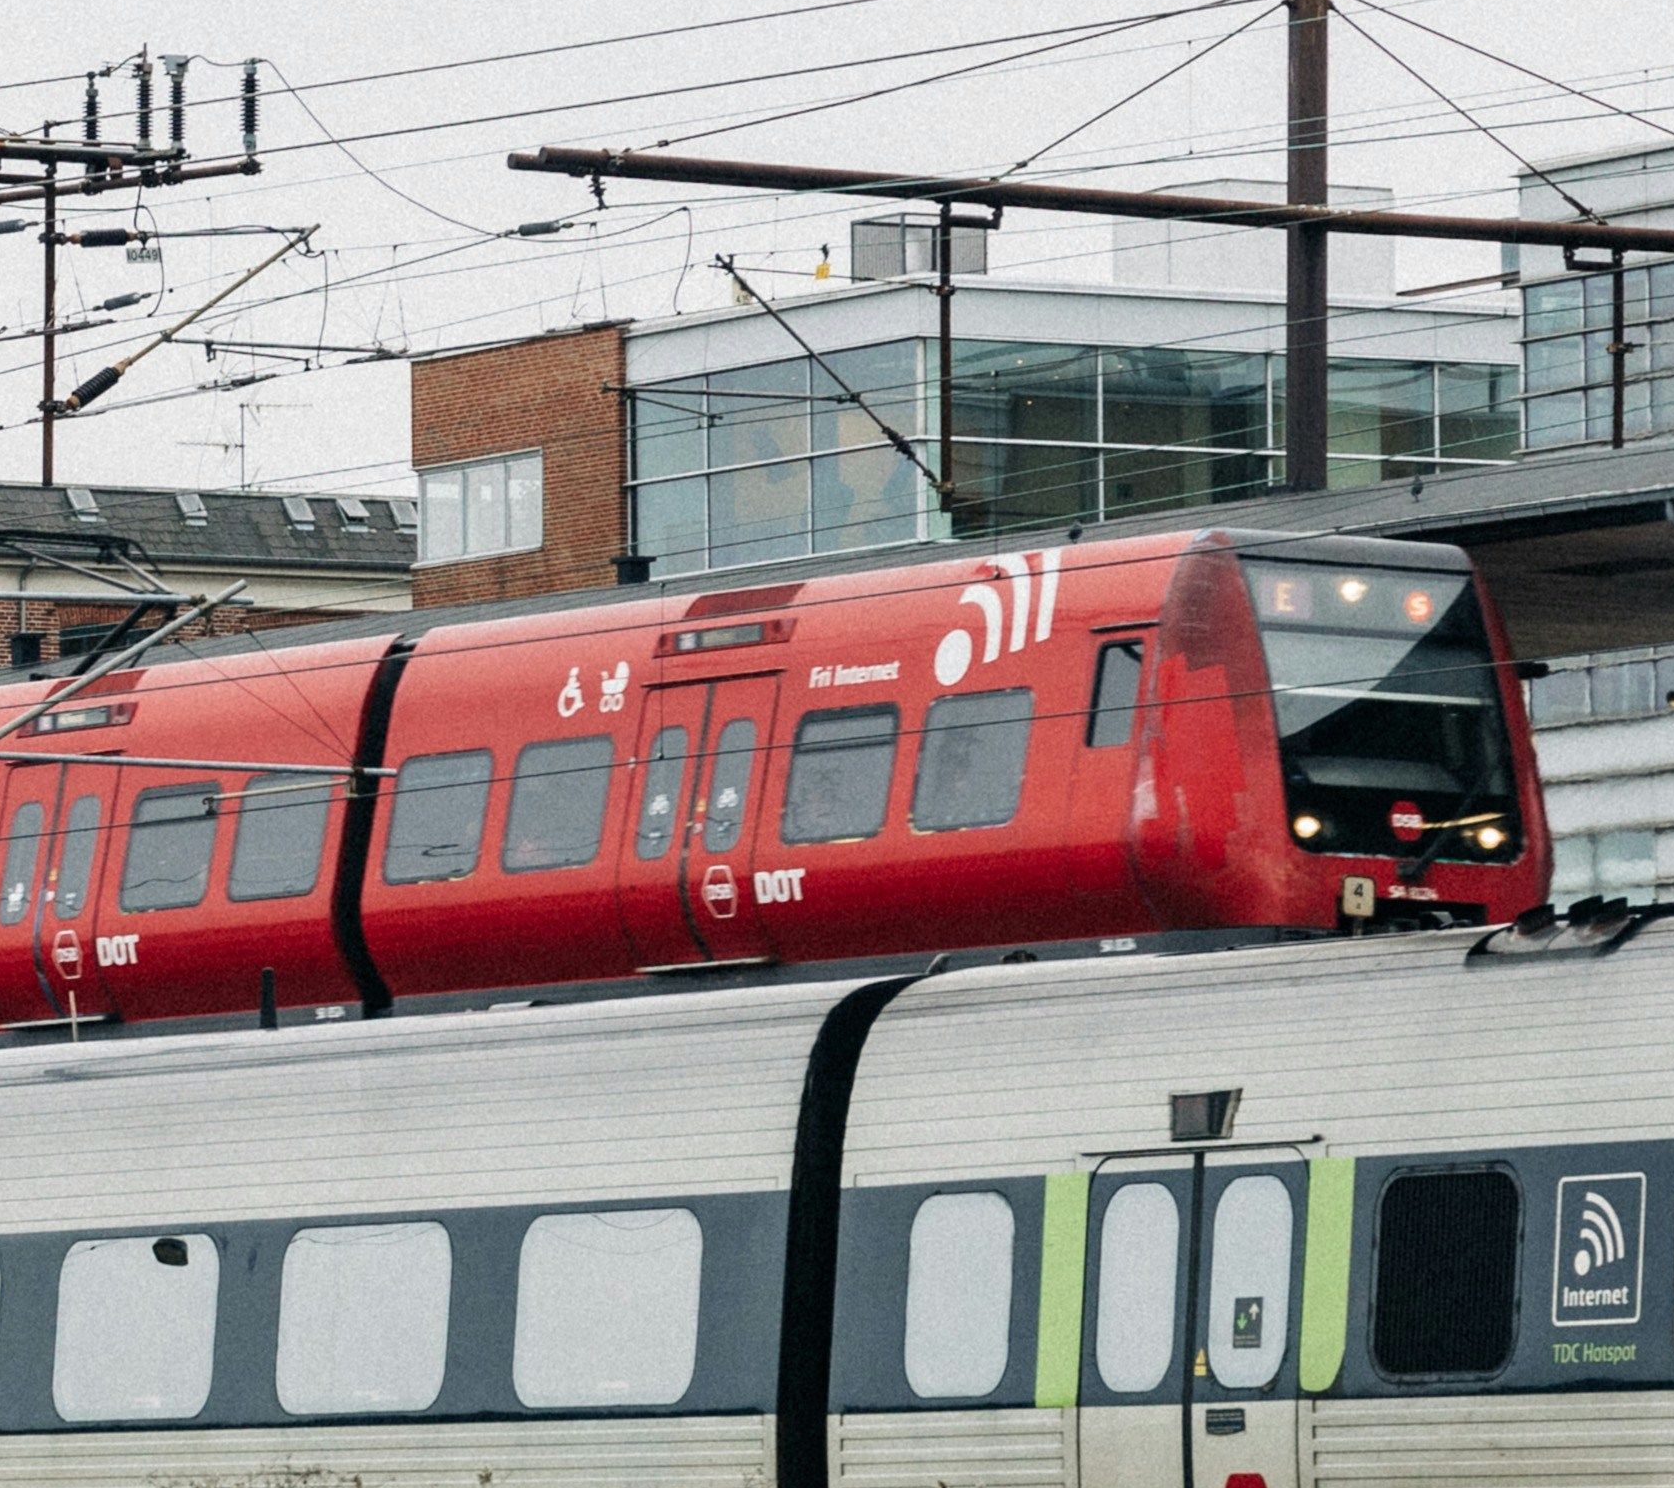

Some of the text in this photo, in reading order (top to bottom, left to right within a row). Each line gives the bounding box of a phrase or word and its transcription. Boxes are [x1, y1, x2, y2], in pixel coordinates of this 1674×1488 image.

[1276, 581, 1295, 612] E
[833, 660, 900, 686] Internet
[704, 883, 736, 901] DSB
[754, 868, 806, 904] DOT
[1353, 883, 1364, 898] 4
[96, 934, 140, 966] DOT
[1562, 1285, 1630, 1307] Internet
[1552, 1342, 1637, 1366] TDC Hotspot
